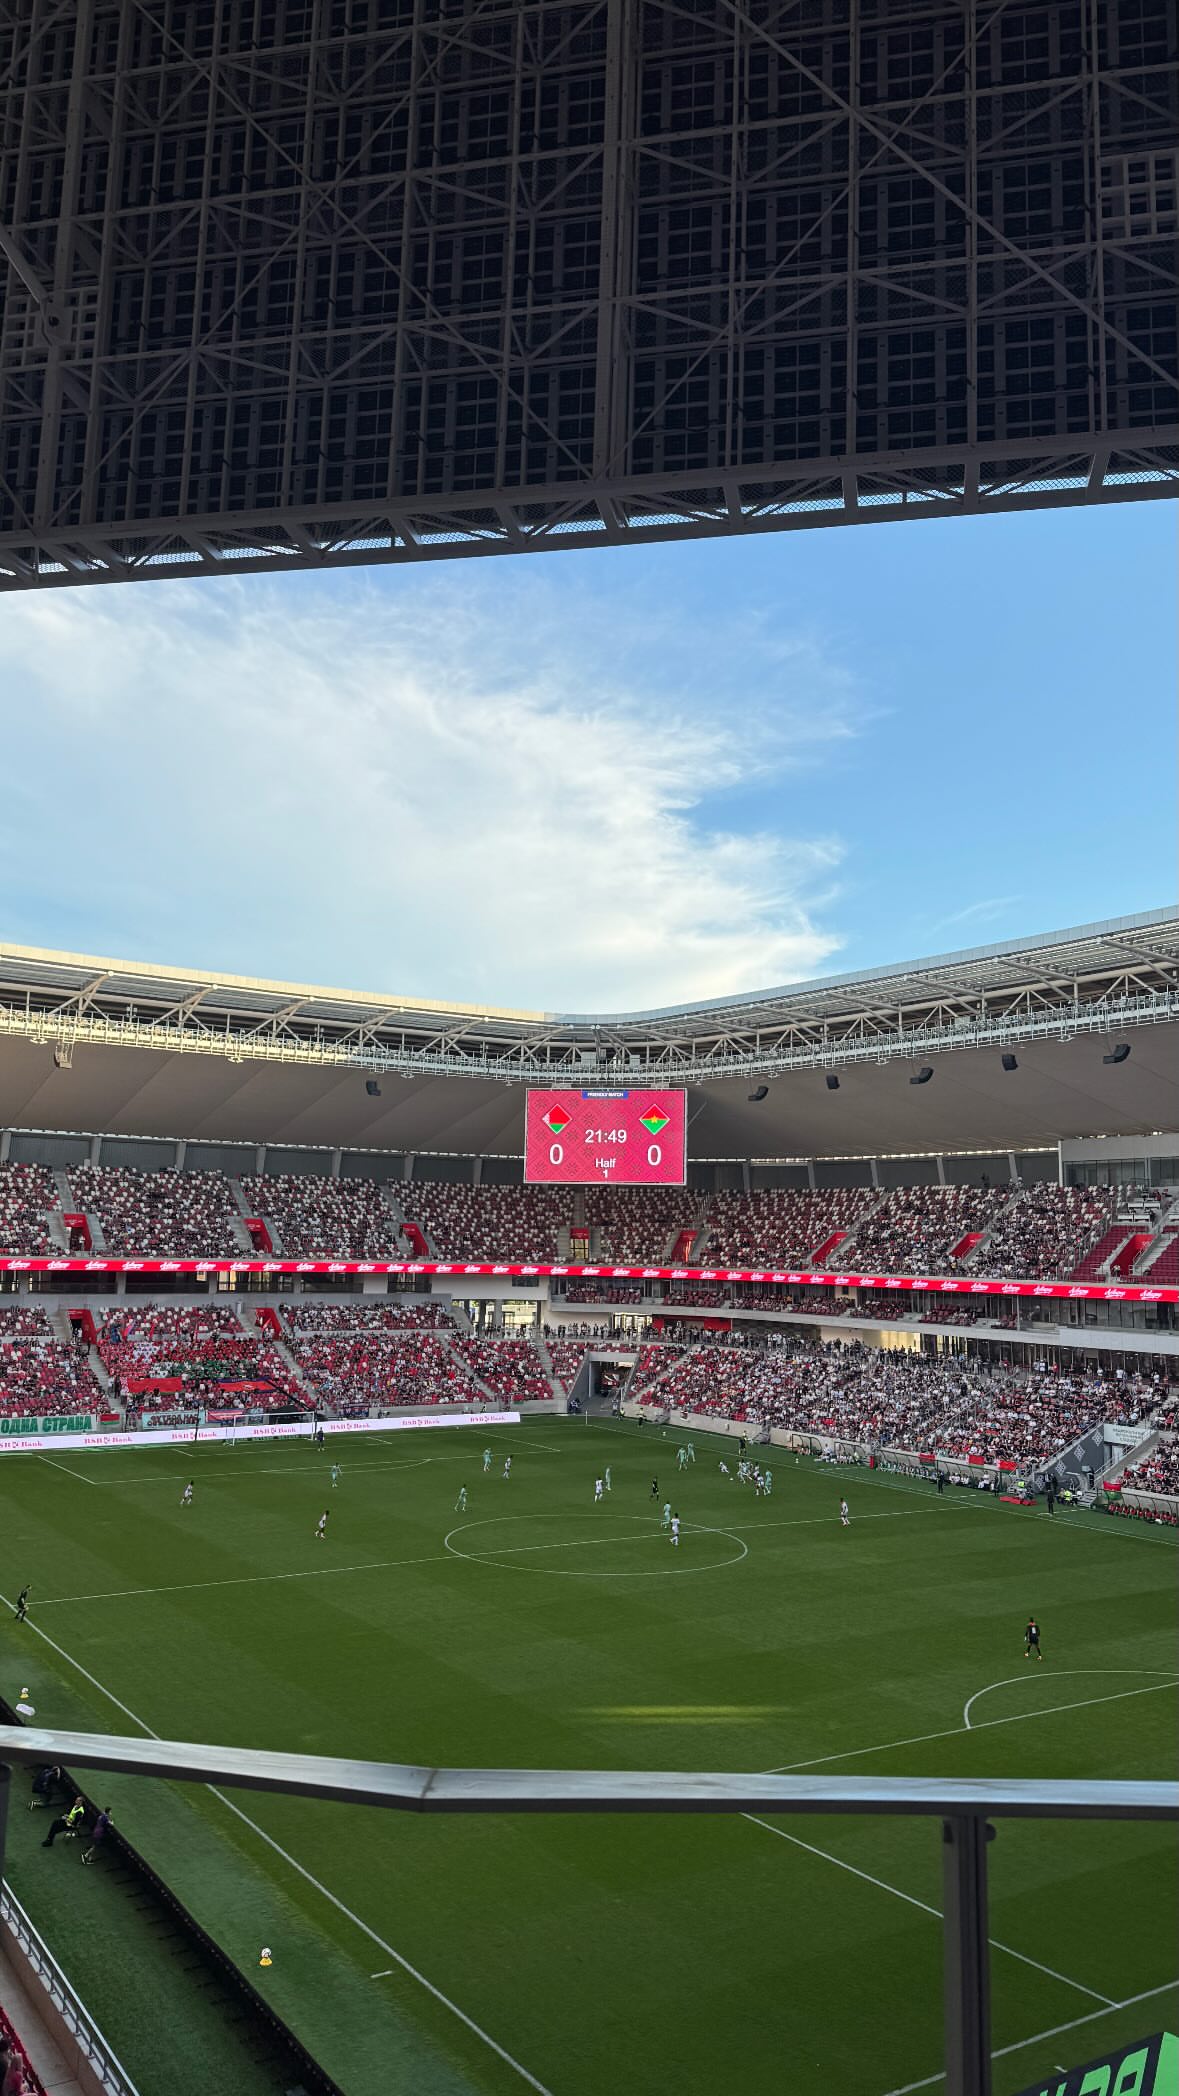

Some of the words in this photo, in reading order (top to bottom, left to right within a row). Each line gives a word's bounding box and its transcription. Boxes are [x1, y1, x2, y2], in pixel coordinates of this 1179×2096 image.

[585, 1130, 627, 1144] 21:49
[549, 1144, 564, 1165] 0
[647, 1145, 662, 1166] 0
[595, 1158, 616, 1168] Half
[603, 1170, 608, 1178] 1
[1, 1418, 38, 1434] ОДНА
[42, 1415, 92, 1433] СТРАНА
